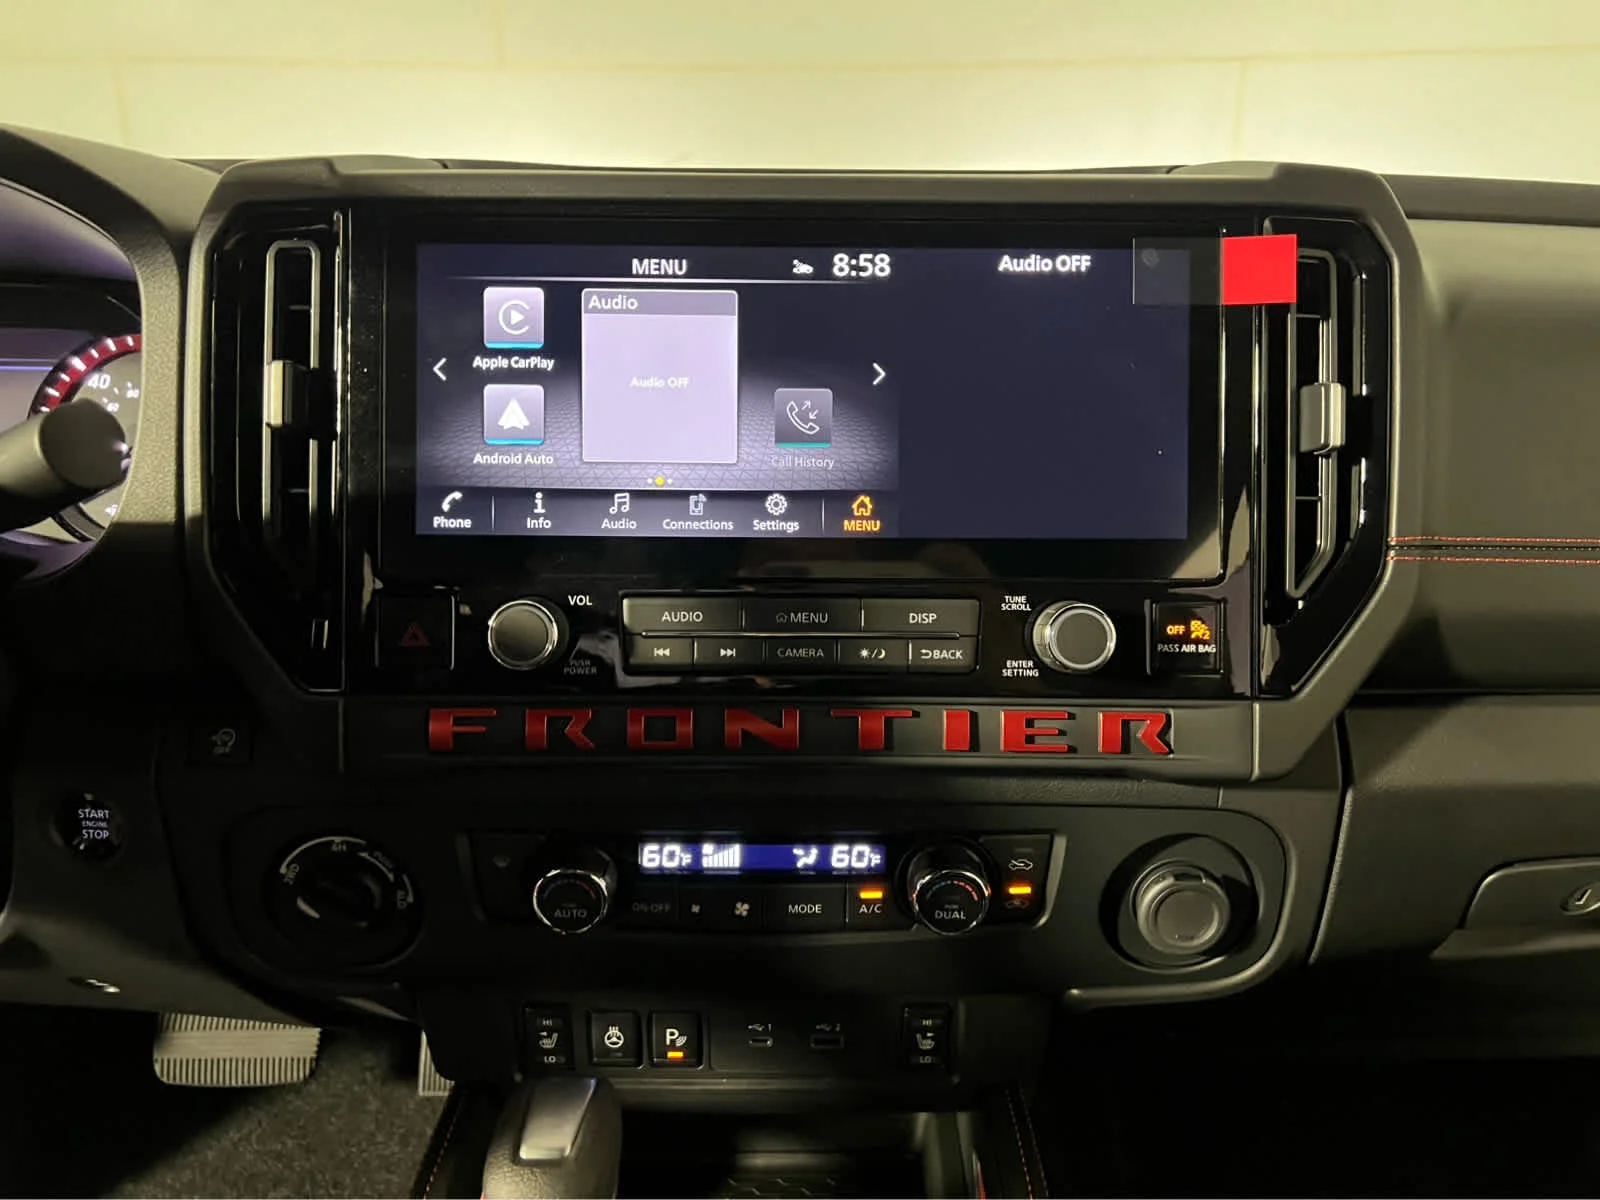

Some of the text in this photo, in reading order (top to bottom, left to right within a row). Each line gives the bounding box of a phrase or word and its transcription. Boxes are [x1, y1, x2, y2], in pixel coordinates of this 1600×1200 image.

[631, 258, 688, 275] MENU
[832, 253, 891, 278] 8:58
[998, 254, 1092, 273] Audio OFF
[588, 295, 639, 311] Audio
[472, 356, 556, 372] Apple CarPlay
[87, 373, 111, 390] 40
[630, 376, 690, 389] Audio OFF
[473, 453, 554, 465] Android Auto
[771, 456, 835, 470] Call History
[433, 516, 472, 529] Phone
[526, 517, 552, 529] Info
[601, 518, 637, 530] Audio
[662, 518, 734, 531] Connections
[753, 518, 800, 533] Settings
[843, 519, 881, 532] MENU
[567, 594, 593, 606] VOL
[1004, 596, 1027, 604] TUNE
[1001, 603, 1032, 611] SCROLL
[660, 611, 704, 623] AUDIO
[790, 612, 829, 624] MENU
[908, 612, 938, 624] DISP
[1166, 625, 1186, 635] OFF
[776, 647, 824, 658] CAMERA
[1157, 643, 1217, 653] PASS AIR BAG
[932, 649, 963, 660] BACK
[1006, 660, 1034, 668] ENTER
[563, 666, 598, 676] POWER
[1002, 668, 1039, 677] SETTING
[428, 707, 1172, 755] FRONTIER
[77, 808, 110, 819] START
[82, 829, 110, 840] STOP
[553, 908, 588, 919] AUTO
[788, 903, 823, 914] MODE
[859, 903, 882, 914] A/C
[934, 910, 967, 920] DUAL
[665, 1028, 680, 1046] P
